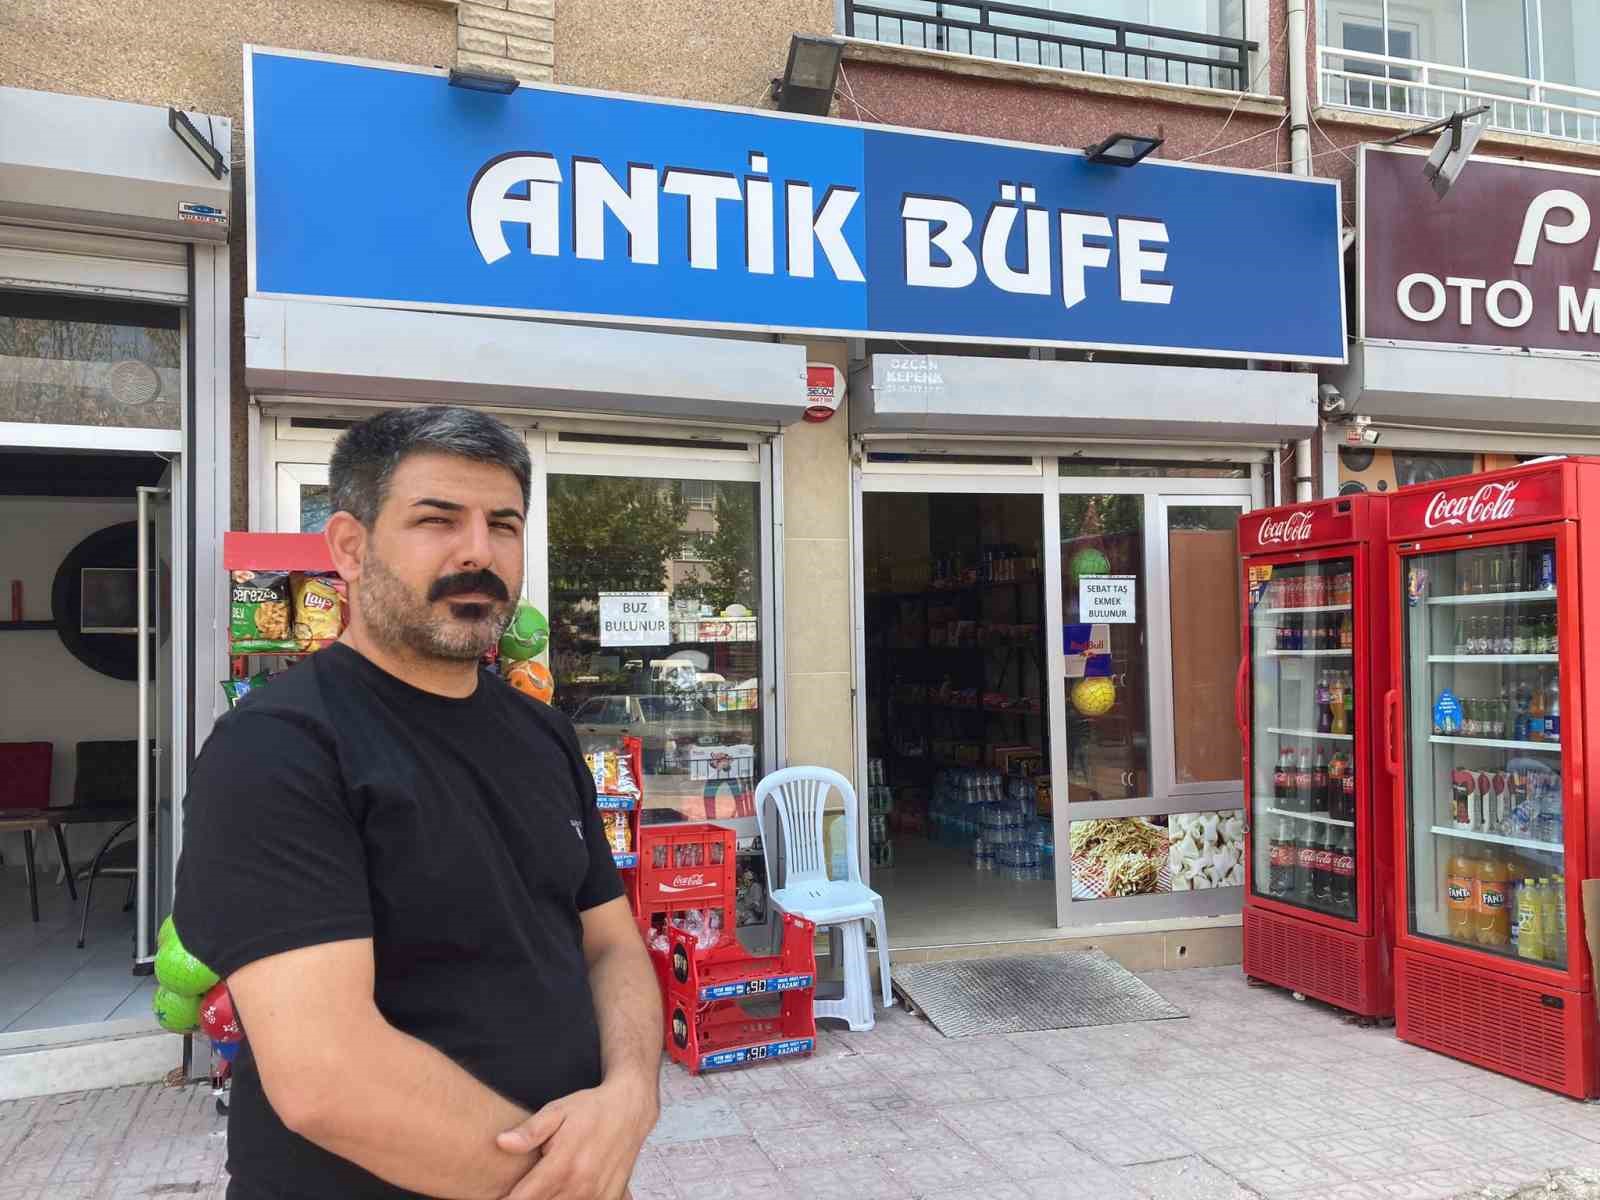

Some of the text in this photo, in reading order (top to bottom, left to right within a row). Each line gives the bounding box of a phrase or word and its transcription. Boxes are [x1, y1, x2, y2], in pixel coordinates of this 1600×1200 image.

[467, 150, 1174, 310] ANTİK BÜFE
[1513, 189, 1600, 272] P
[1397, 273, 1533, 328] OTO
[1087, 585, 1128, 594] SEBAT TAŞ
[1094, 597, 1121, 606] EKMEK
[623, 602, 648, 614] BUZ
[1088, 609, 1127, 618] BULUNUR
[604, 620, 665, 632] BULUNUR
